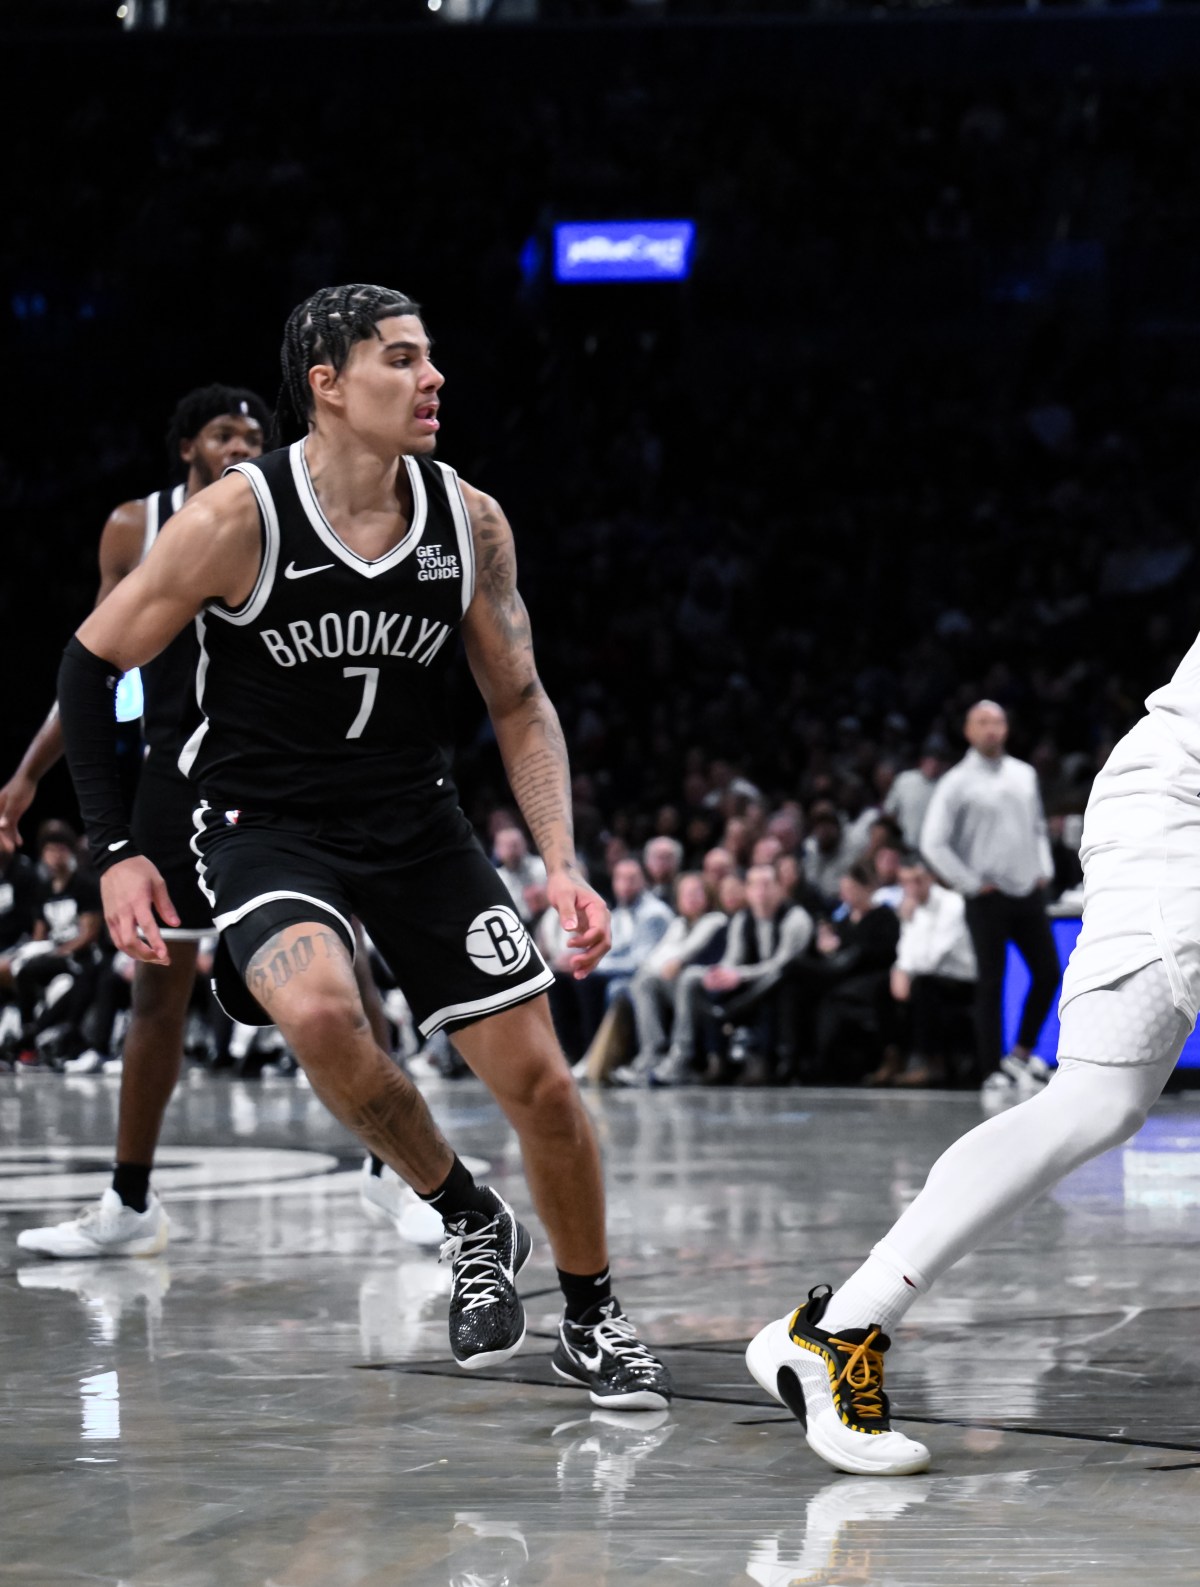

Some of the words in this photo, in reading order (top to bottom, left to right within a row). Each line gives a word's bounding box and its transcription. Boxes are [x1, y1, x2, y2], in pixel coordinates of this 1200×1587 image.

[416, 545, 442, 557] GET
[417, 555, 457, 569] YOUR
[417, 566, 460, 581] GUIDE
[260, 610, 453, 668] BROOKLYN
[343, 667, 380, 739] 7
